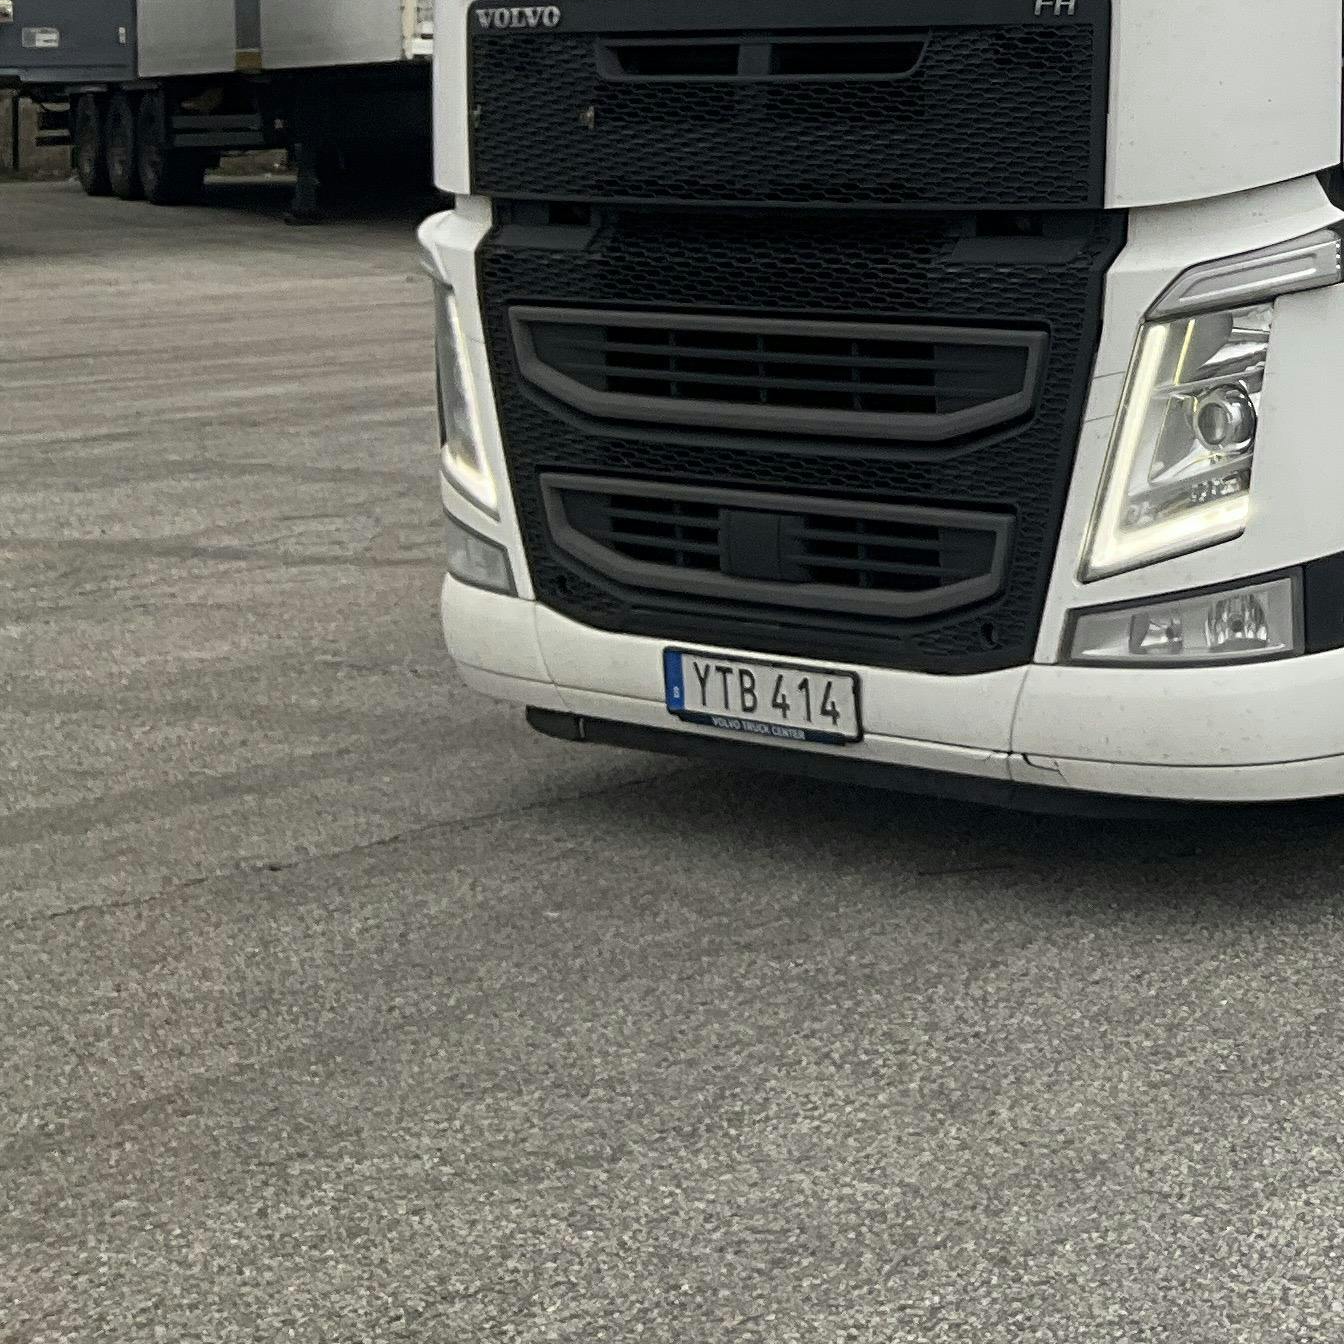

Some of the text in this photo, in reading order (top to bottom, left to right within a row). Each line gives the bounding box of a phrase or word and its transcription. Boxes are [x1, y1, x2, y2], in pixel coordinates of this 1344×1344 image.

[475, 6, 561, 29] VOLVO
[692, 661, 841, 726] YTB 414
[712, 716, 806, 740] VOLVO TRUCK CENTER
